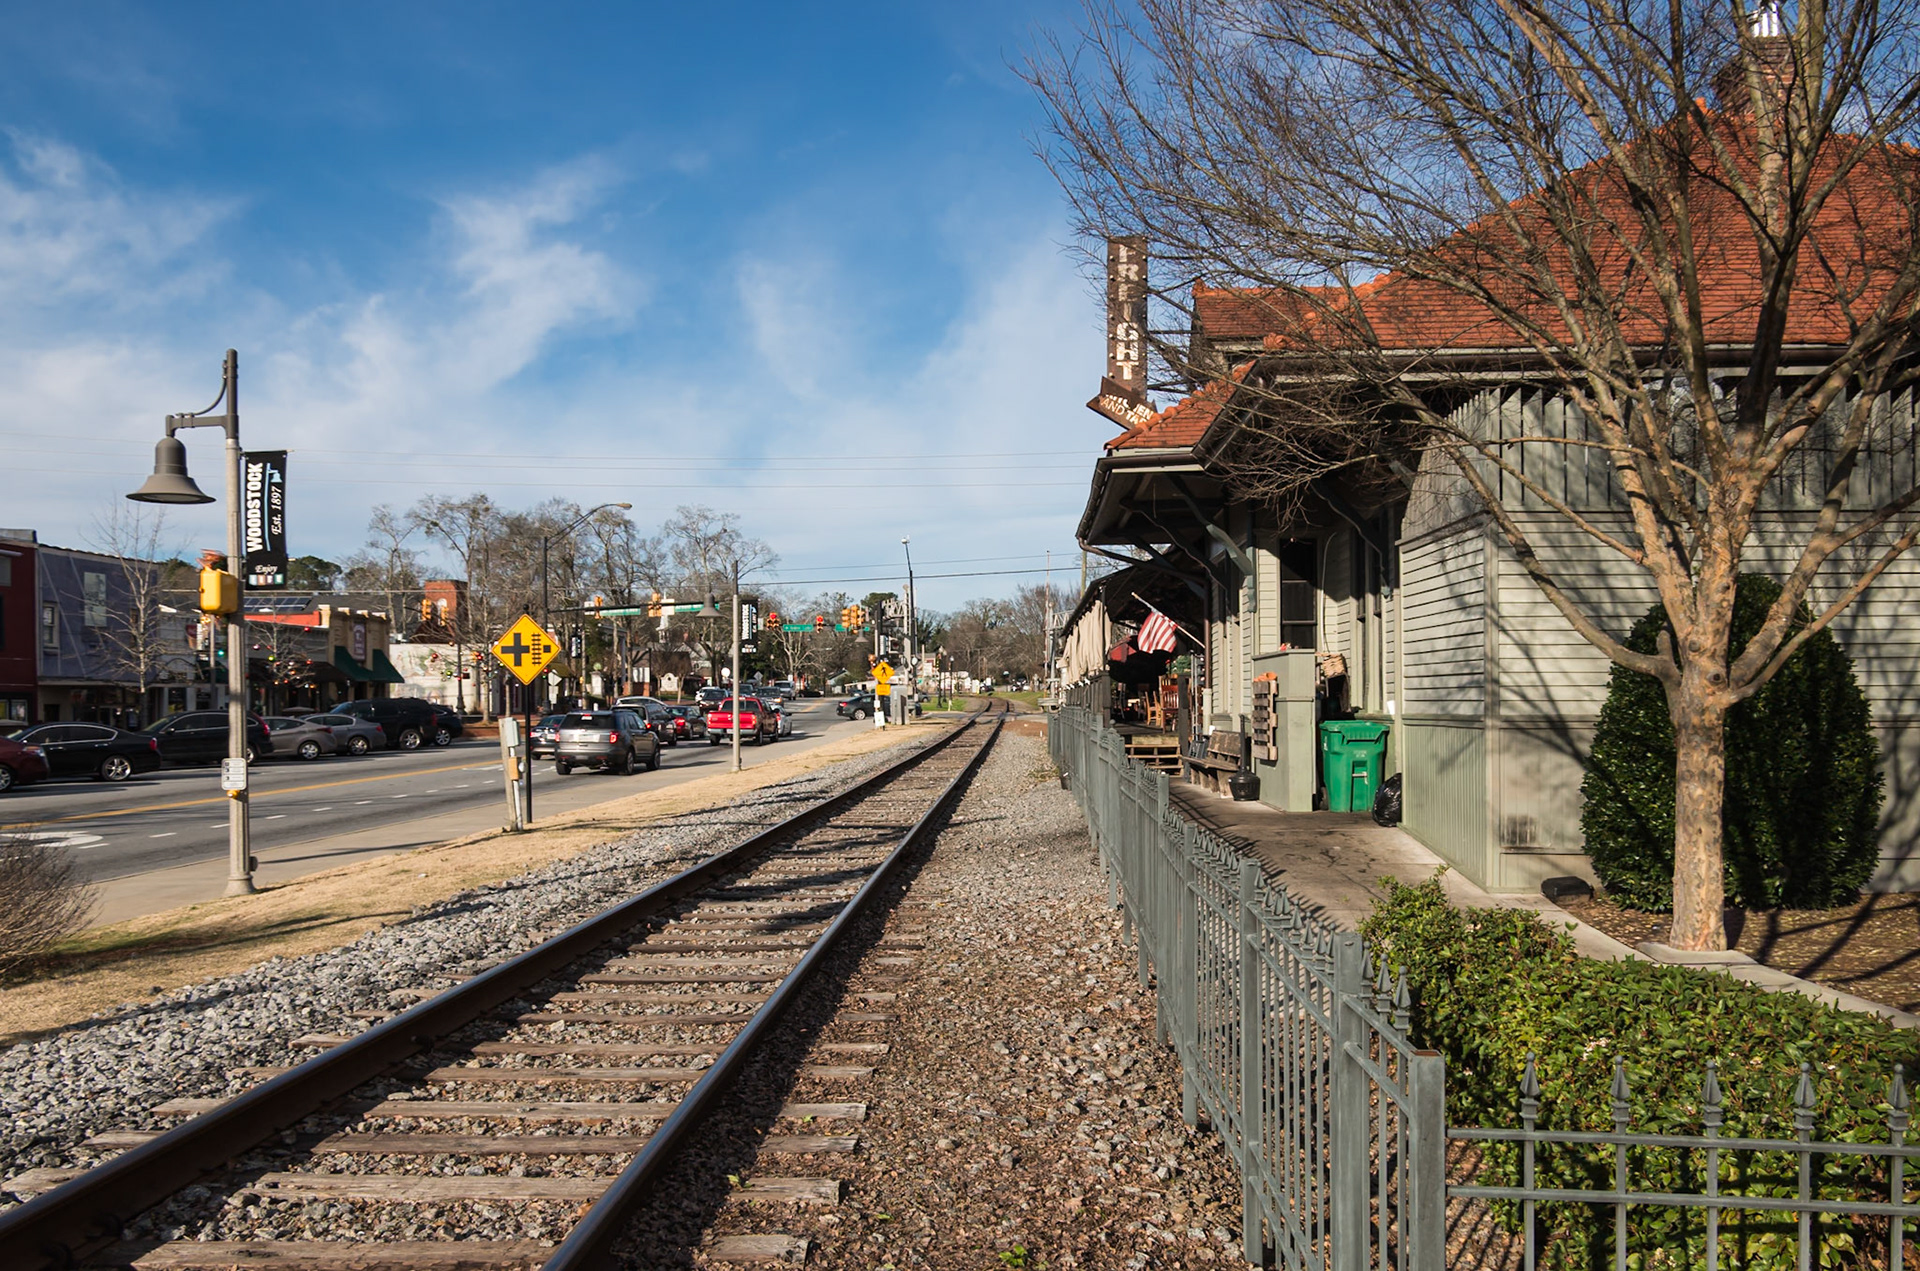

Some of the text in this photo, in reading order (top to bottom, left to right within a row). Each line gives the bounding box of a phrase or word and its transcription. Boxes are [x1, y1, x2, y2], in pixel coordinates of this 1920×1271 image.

[1116, 244, 1139, 380] FREIGHT
[1100, 398, 1125, 415] AND
[247, 462, 263, 552] WOODSTOCK
[271, 486, 282, 535] Est. 1897
[255, 564, 278, 575] Enjoy
